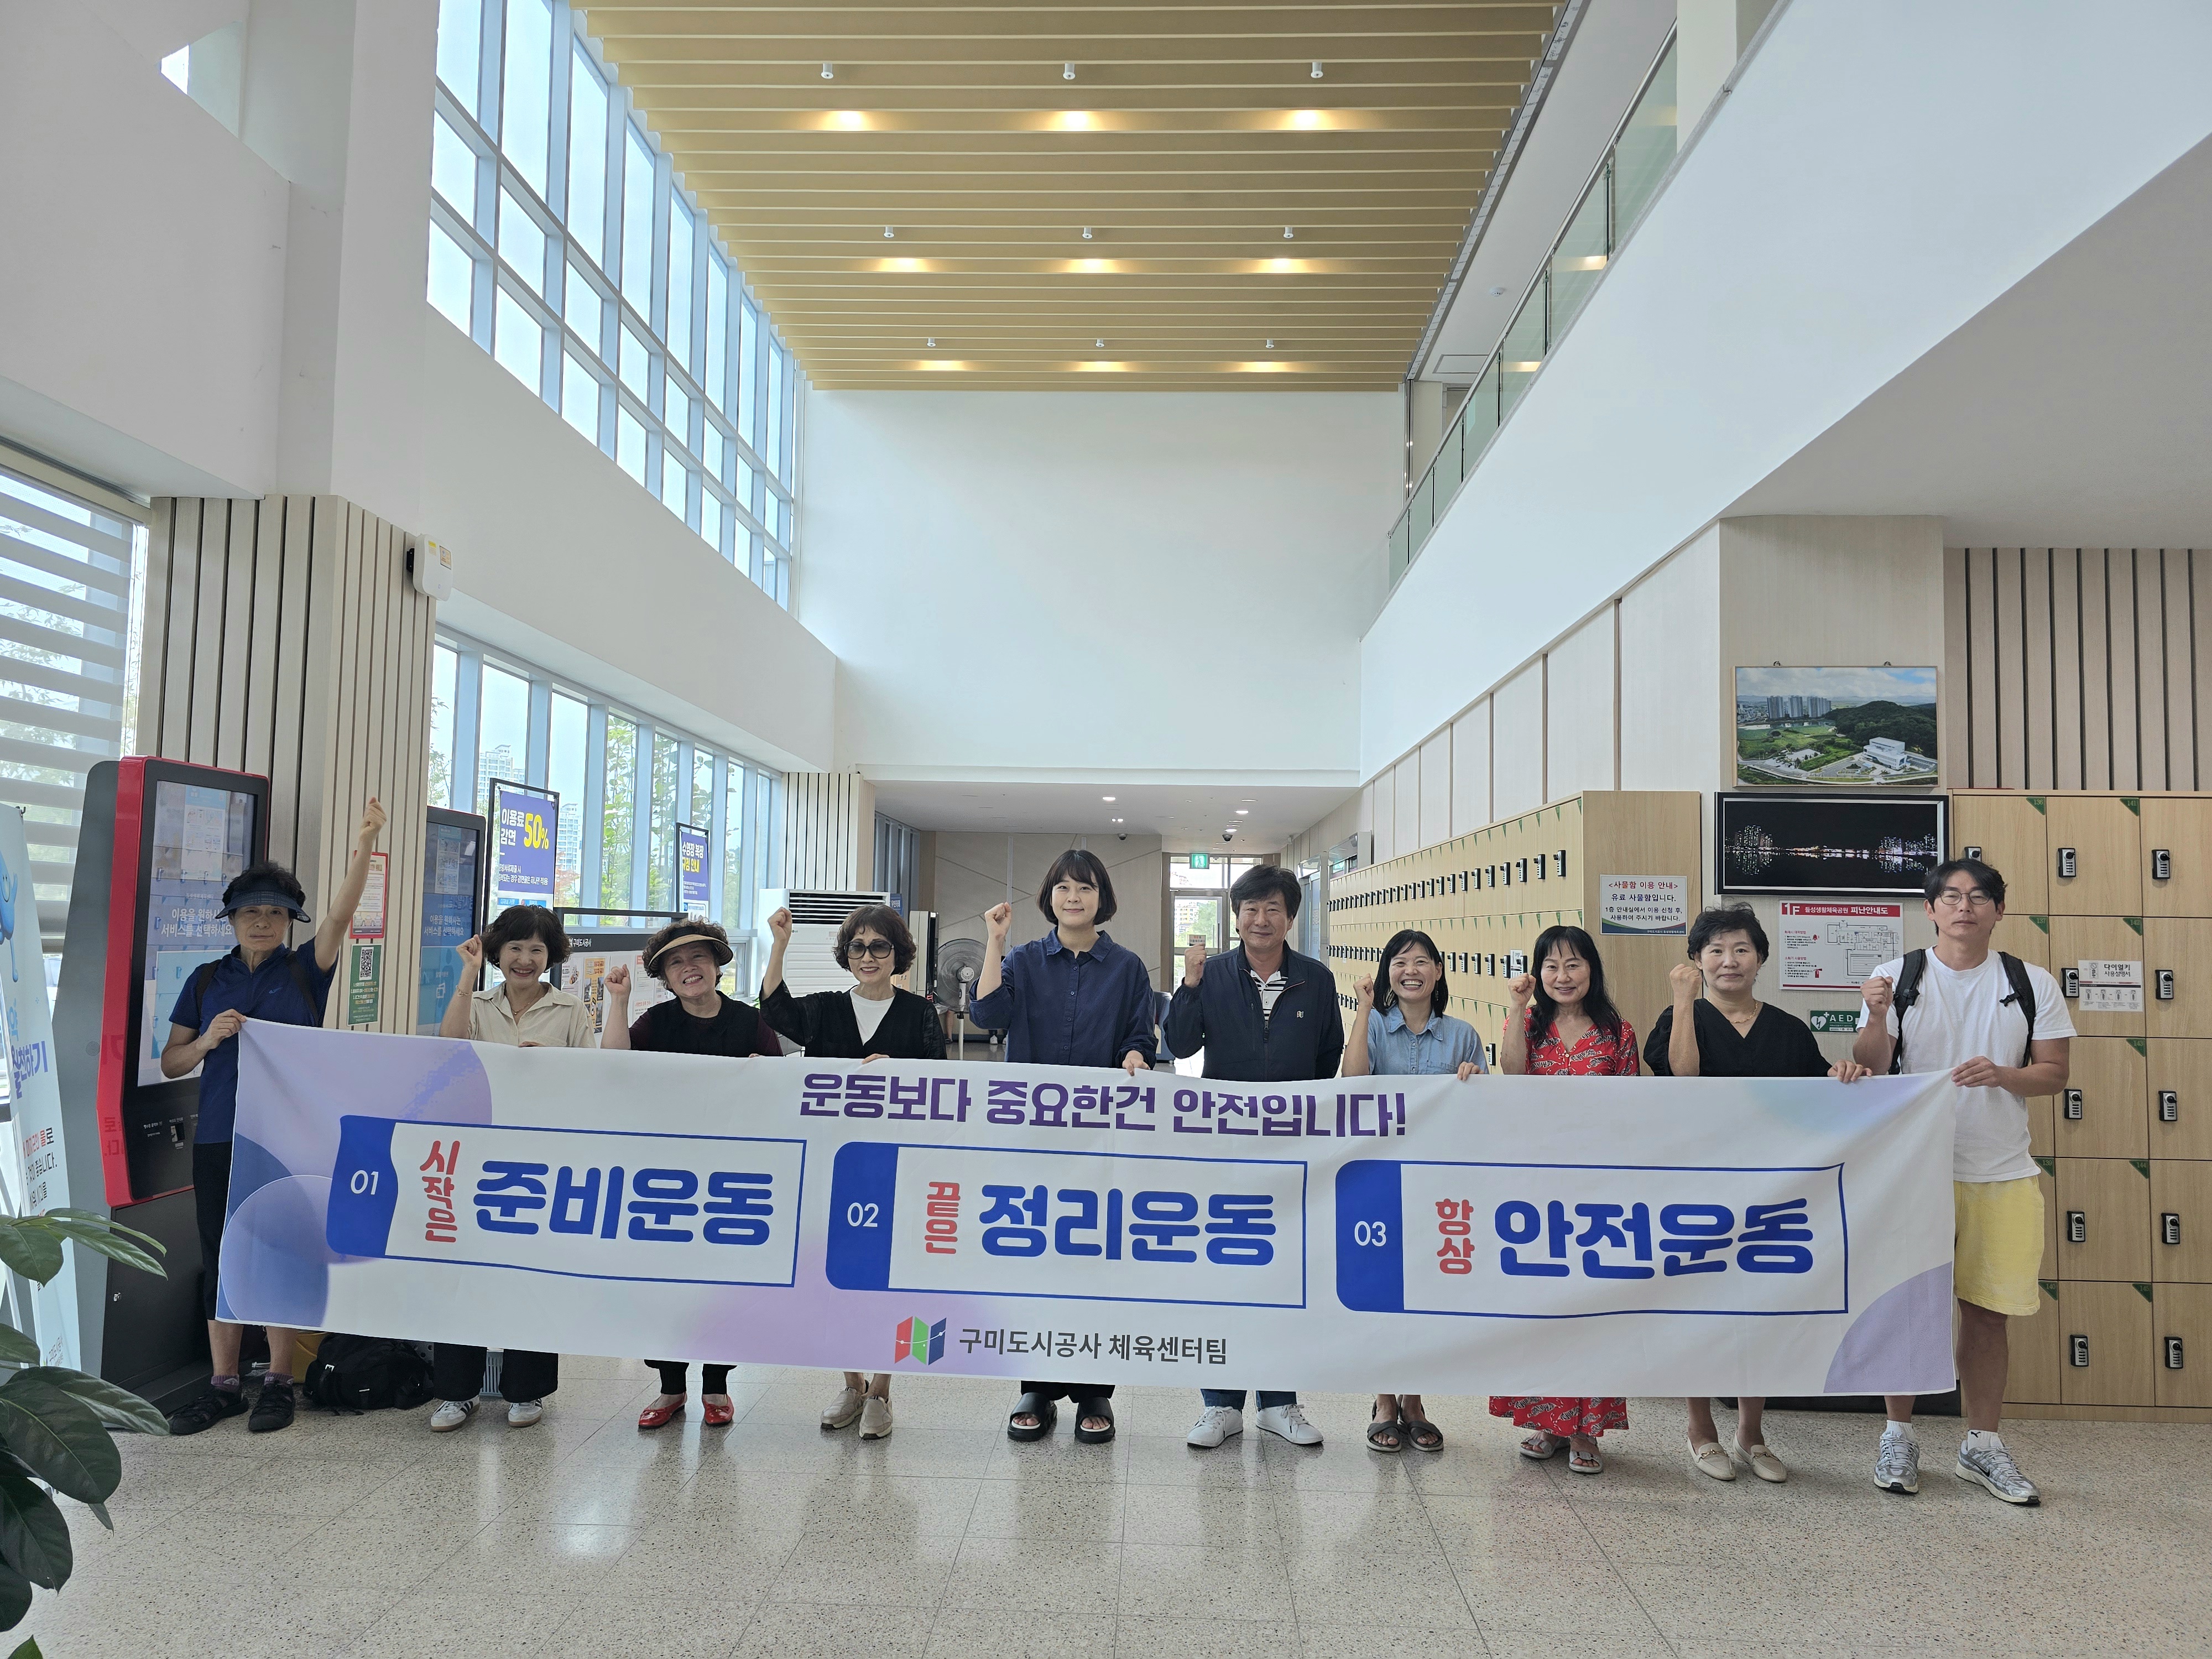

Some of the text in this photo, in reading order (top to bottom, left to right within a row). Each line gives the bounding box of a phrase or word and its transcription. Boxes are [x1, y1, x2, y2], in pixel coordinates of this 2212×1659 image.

[500, 828, 517, 846] 감면
[502, 808, 549, 849] 이용료 50%
[682, 841, 704, 858] 수영장 복장
[691, 858, 700, 873] 안내
[540, 877, 549, 885] 적용
[1608, 881, 1637, 889] <사물함
[1658, 881, 1679, 890] 안내>
[1629, 894, 1676, 902] 사물함입니다.
[1784, 902, 1801, 915] 1F
[1850, 906, 1888, 915] 피난안내도
[171, 907, 196, 922] 이용을
[430, 915, 461, 926] 이용을 원하시는
[161, 923, 233, 938] 서비스를 선택하세요
[424, 926, 464, 937] 서비스를 선택하세요
[573, 938, 592, 947] 구미도시공사
[11, 1040, 49, 1099] 실천하기
[800, 1074, 1405, 1137] 운동보다 중요한건 안전입니다!
[40, 1127, 54, 1147] 물로
[35, 1152, 58, 1177] 좋습니다.
[351, 1170, 379, 1195] 01
[421, 1140, 461, 1243] 시작은
[473, 1161, 774, 1246] 준비운동
[847, 1202, 878, 1227] 02
[925, 1181, 961, 1255] 끝은
[979, 1185, 1276, 1266] 정리운동
[1354, 1220, 1386, 1246] 03
[1435, 1198, 1474, 1275] 항상
[1494, 1198, 1813, 1279] 안전운동
[959, 1328, 1227, 1365] 구미도시공사 체육센터팀
